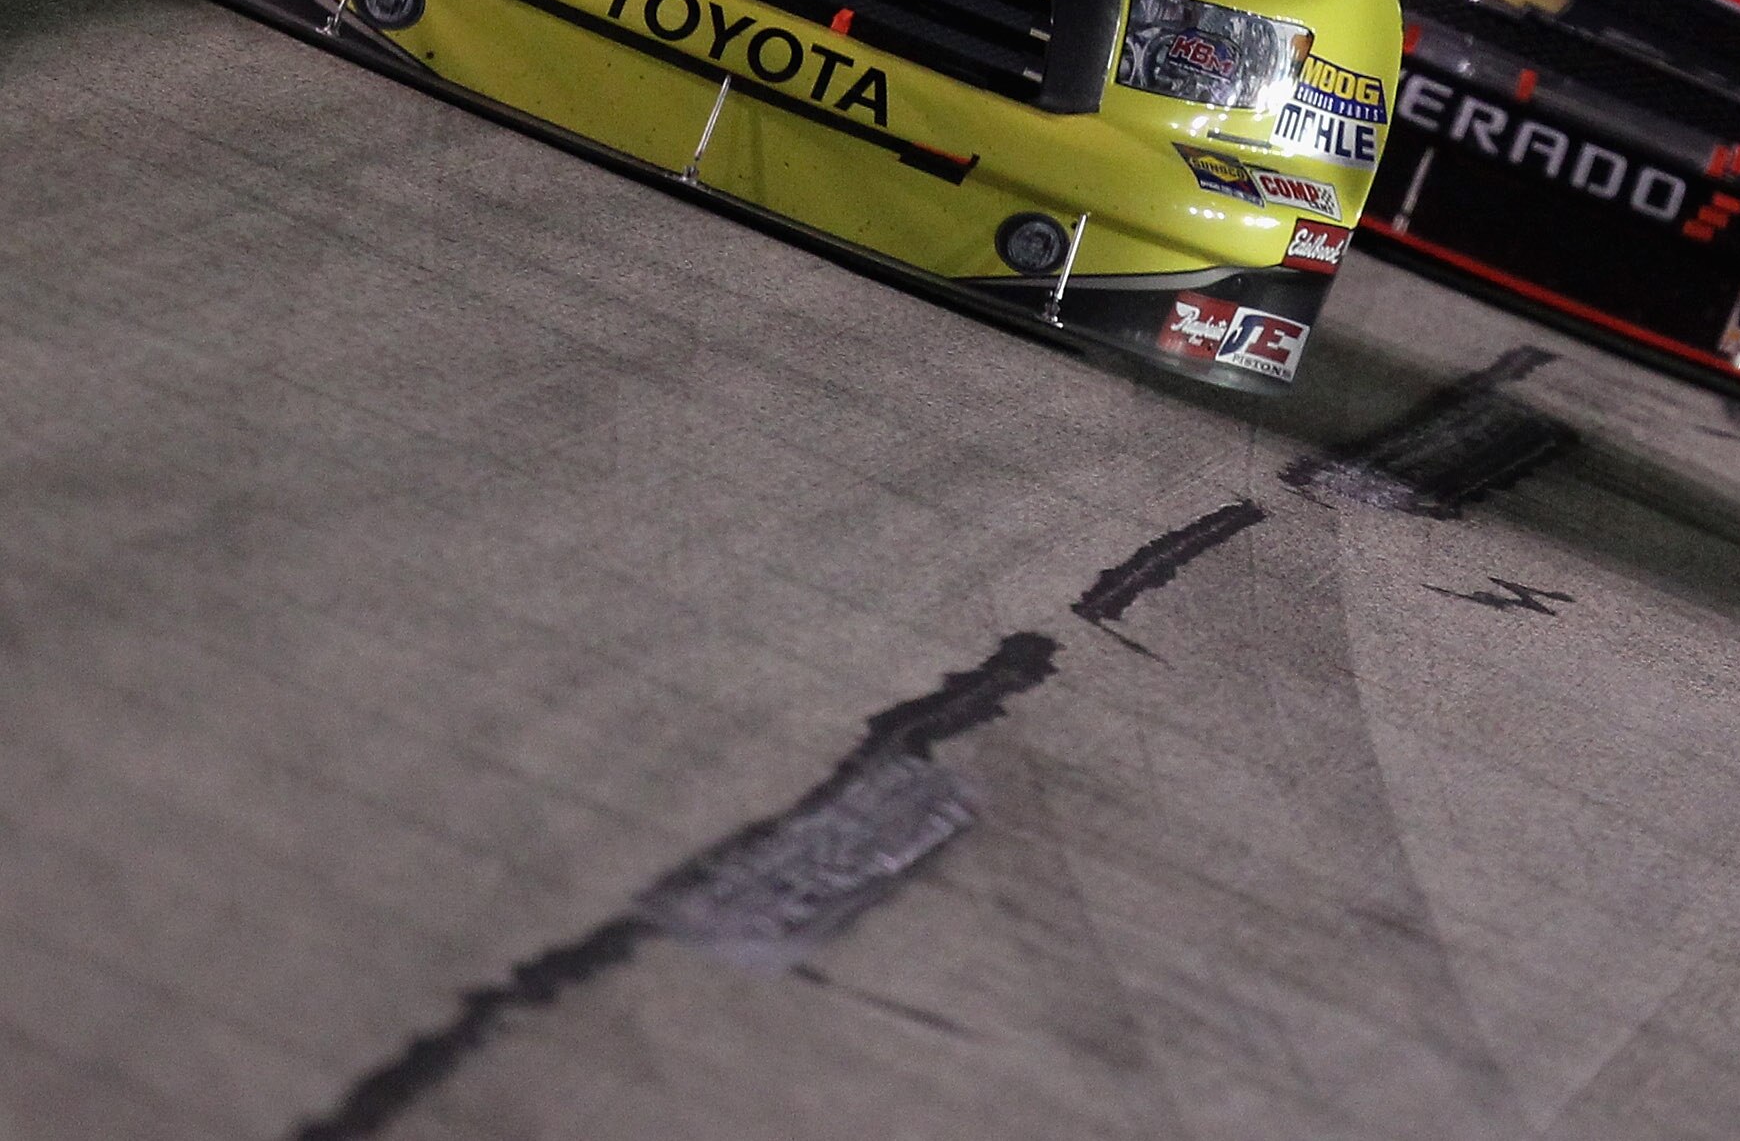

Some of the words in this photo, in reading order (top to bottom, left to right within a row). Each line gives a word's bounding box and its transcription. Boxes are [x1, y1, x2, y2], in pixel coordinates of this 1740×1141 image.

[1168, 34, 1234, 77] KBM
[1302, 56, 1381, 106] MOOG
[1338, 96, 1380, 122] PARTS
[1398, 72, 1687, 222] ERADO
[1259, 173, 1320, 203] COMP
[1219, 314, 1303, 364] JE
